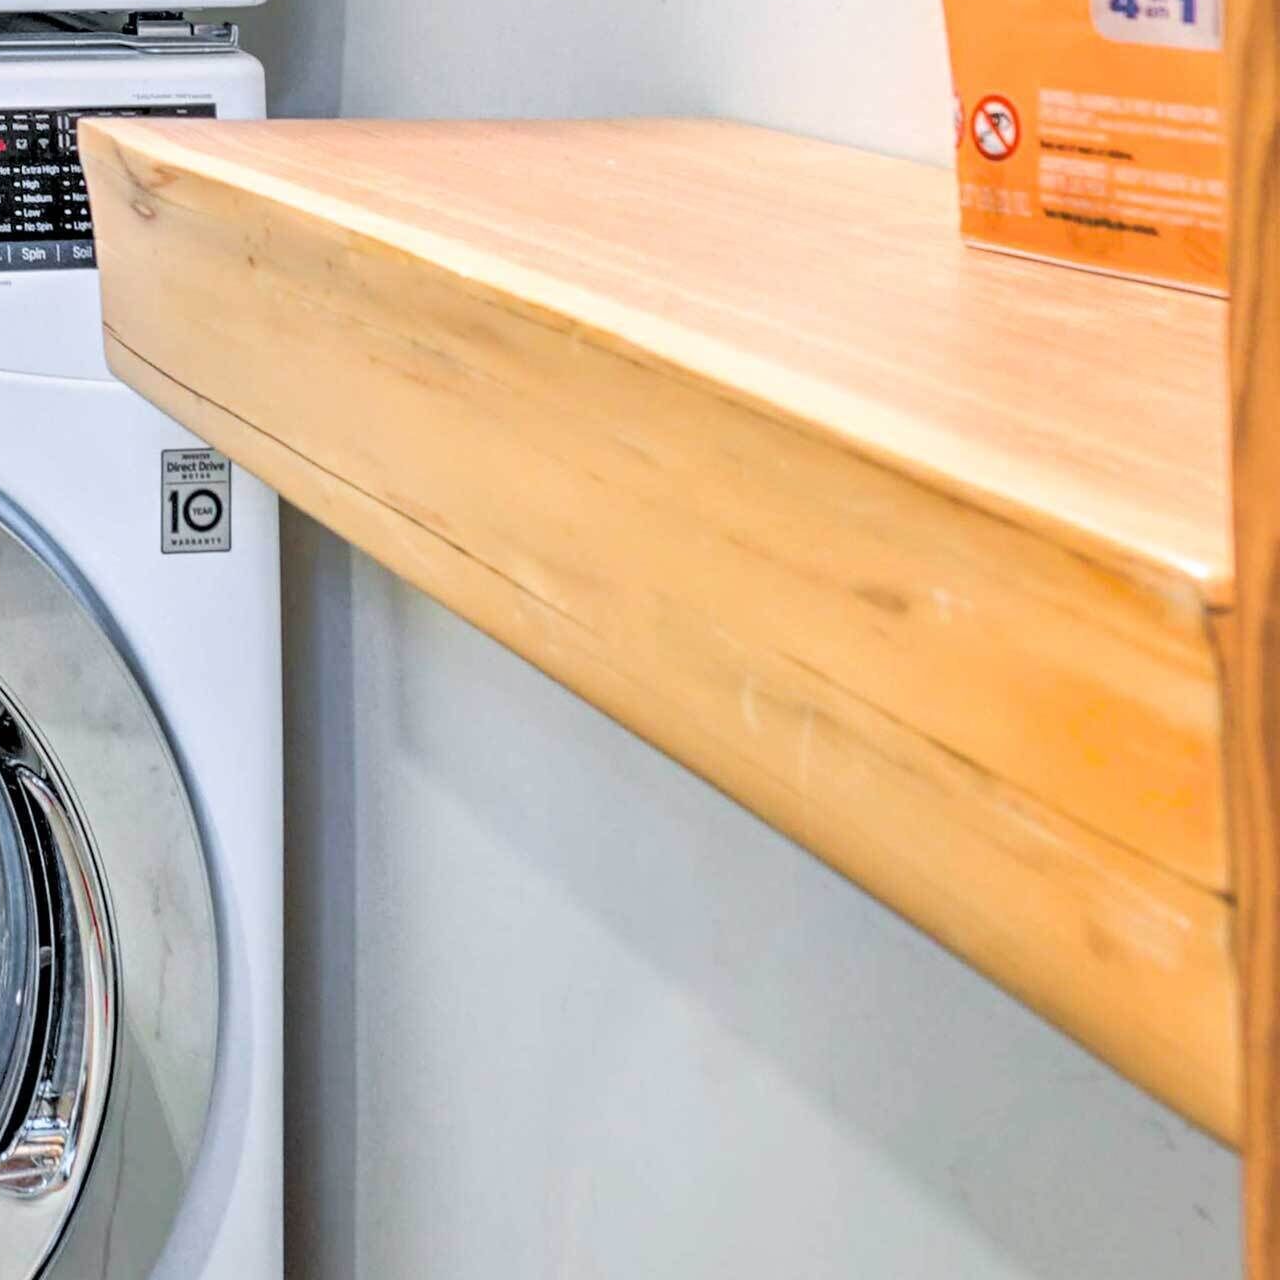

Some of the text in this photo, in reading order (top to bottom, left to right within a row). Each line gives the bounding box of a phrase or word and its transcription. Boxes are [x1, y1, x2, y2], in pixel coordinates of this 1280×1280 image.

[42, 164, 60, 176] High
[22, 180, 40, 192] High
[22, 194, 53, 203] Medium
[23, 208, 41, 218] Low
[24, 222, 54, 234] No Spin
[73, 221, 92, 233] Ligh
[21, 247, 47, 263] Spin
[166, 461, 225, 473] Direct Drive
[168, 488, 223, 534] 10
[192, 507, 214, 516] YEAR
